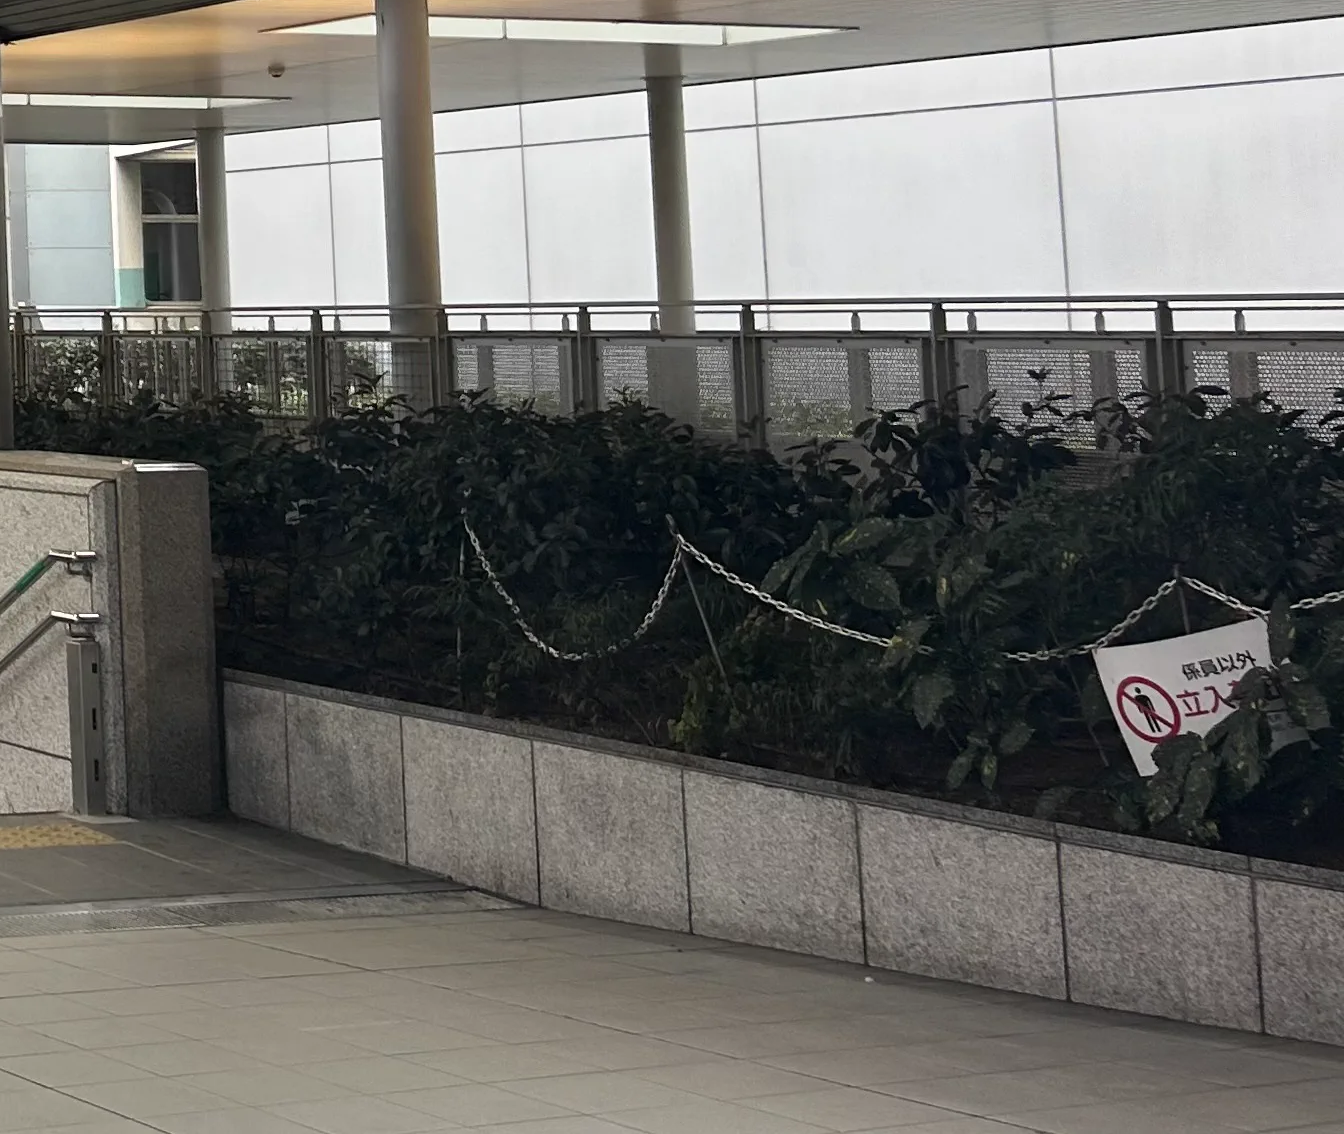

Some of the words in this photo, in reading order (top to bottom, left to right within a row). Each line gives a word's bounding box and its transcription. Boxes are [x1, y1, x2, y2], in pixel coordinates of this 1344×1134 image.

[1181, 649, 1257, 681] 係員以外
[1176, 679, 1241, 717] 立入
